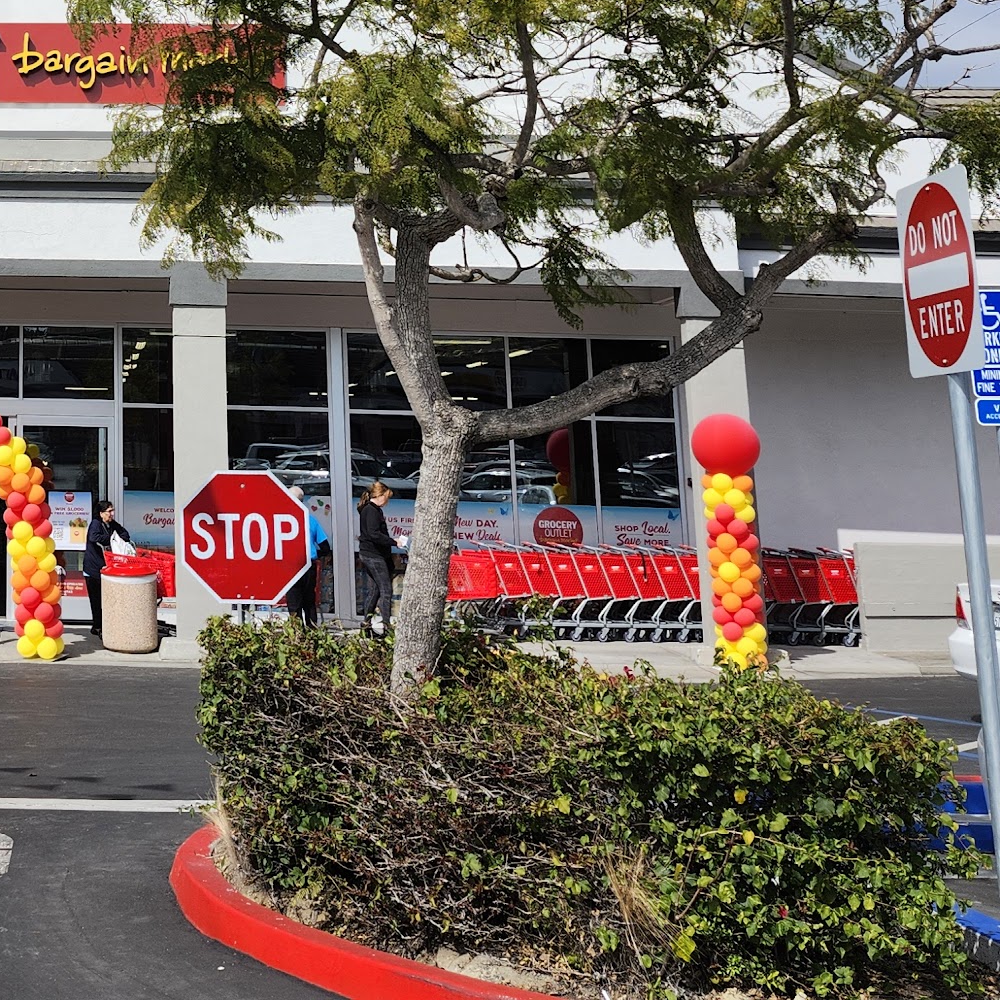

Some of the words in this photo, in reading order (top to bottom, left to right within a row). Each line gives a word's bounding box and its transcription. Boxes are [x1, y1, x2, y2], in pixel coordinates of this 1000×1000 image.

[11, 32, 149, 89] bargain
[908, 225, 926, 256] DO
[931, 210, 957, 249] NOT
[918, 299, 965, 339] ENTER
[977, 382, 996, 393] FINE
[143, 513, 175, 528] Bargai
[476, 520, 499, 528] DAY.
[538, 520, 577, 529] GROCERY
[391, 525, 412, 536] Mor
[545, 529, 572, 538] OUTLET
[641, 521, 671, 537] Local.
[190, 513, 299, 561] STOP
[616, 534, 642, 546] Save
